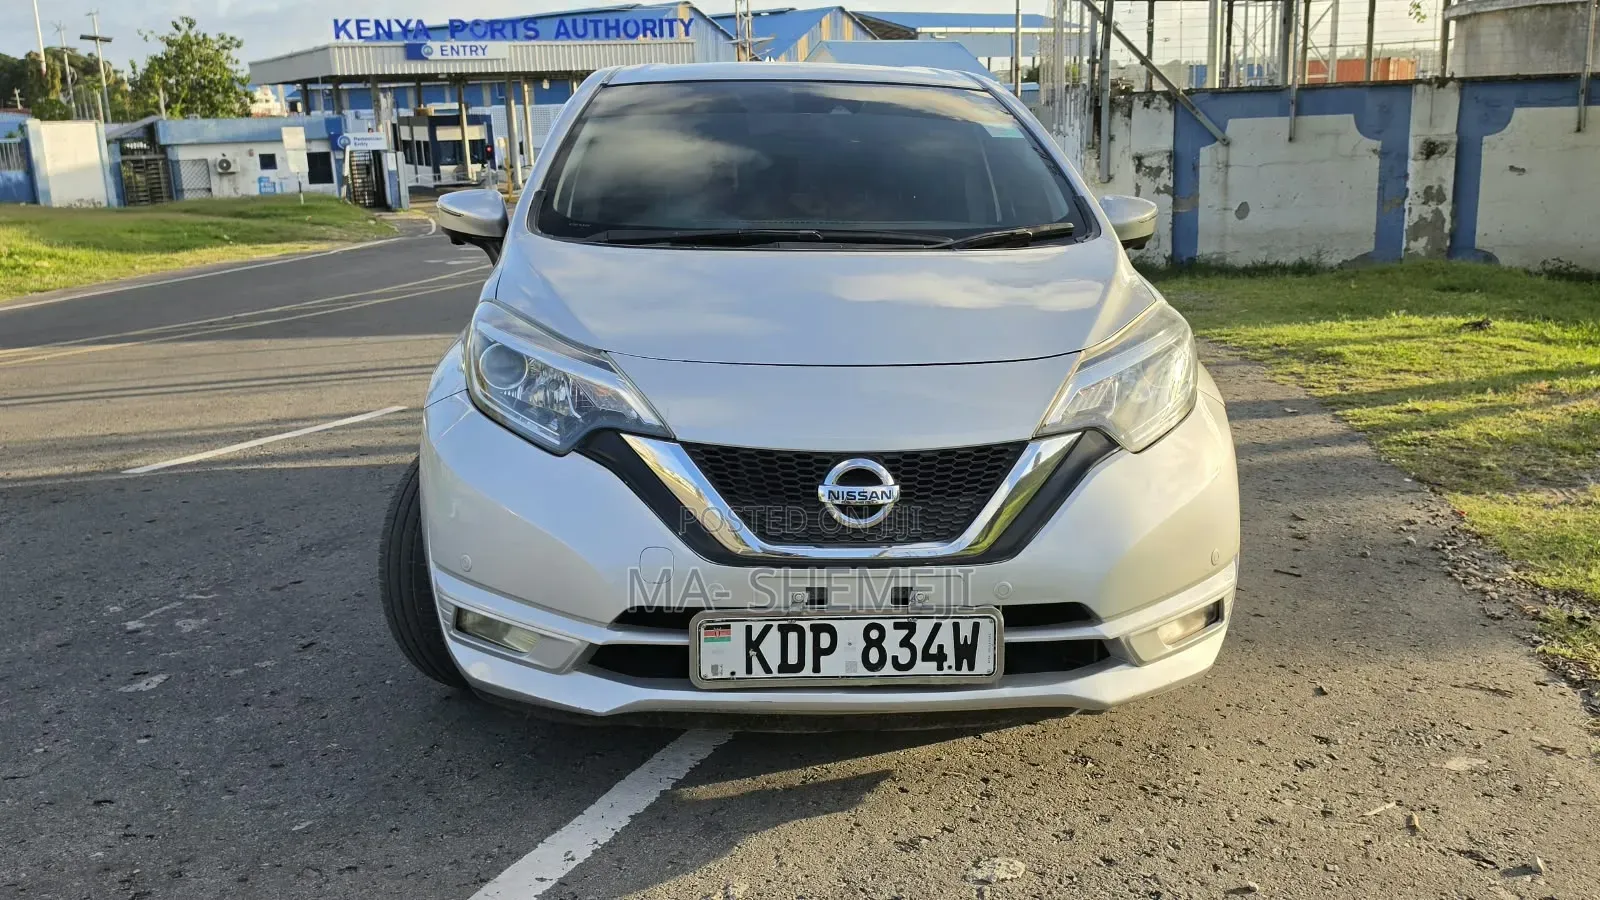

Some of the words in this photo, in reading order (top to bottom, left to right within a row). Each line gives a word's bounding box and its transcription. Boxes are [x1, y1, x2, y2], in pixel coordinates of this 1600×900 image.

[333, 18, 432, 40] KENYA
[448, 18, 540, 40] PORTS
[554, 17, 695, 40] AUTHORITY
[439, 44, 489, 57] ENTRY
[827, 489, 892, 501] NISSAN
[745, 622, 838, 675] KDP
[861, 621, 981, 673] 834W
